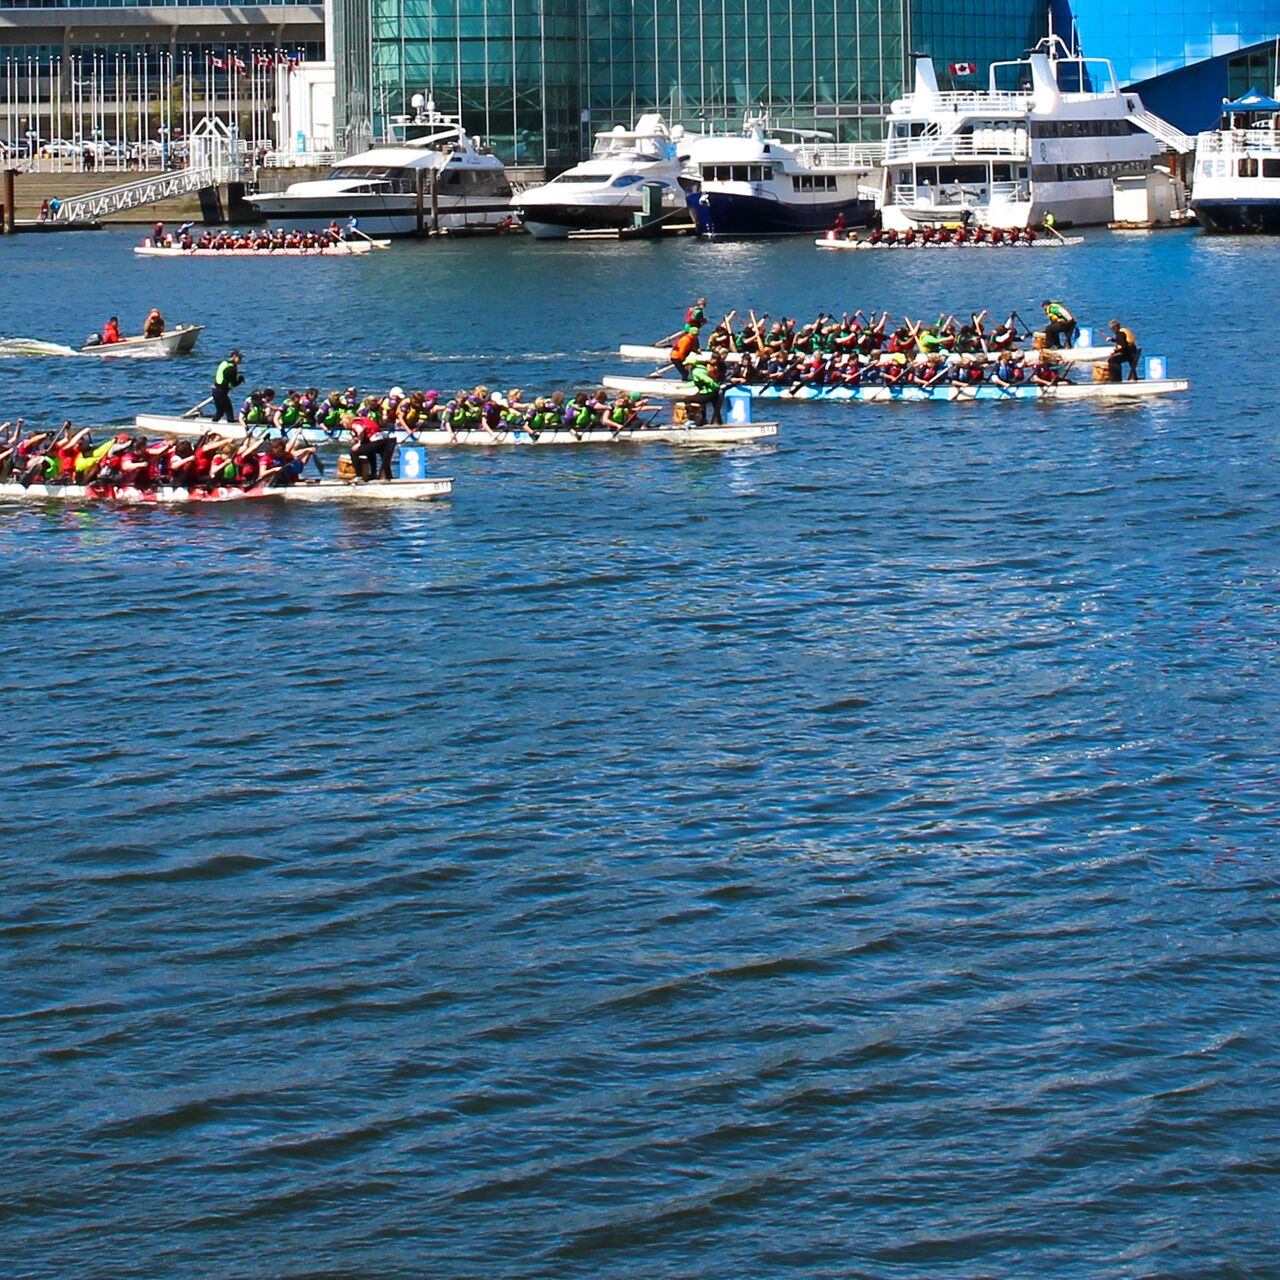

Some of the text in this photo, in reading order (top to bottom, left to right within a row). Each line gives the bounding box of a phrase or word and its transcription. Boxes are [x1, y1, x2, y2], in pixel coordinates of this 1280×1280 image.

[1149, 358, 1161, 378] 5
[732, 399, 745, 422] 4
[405, 451, 419, 476] 3
